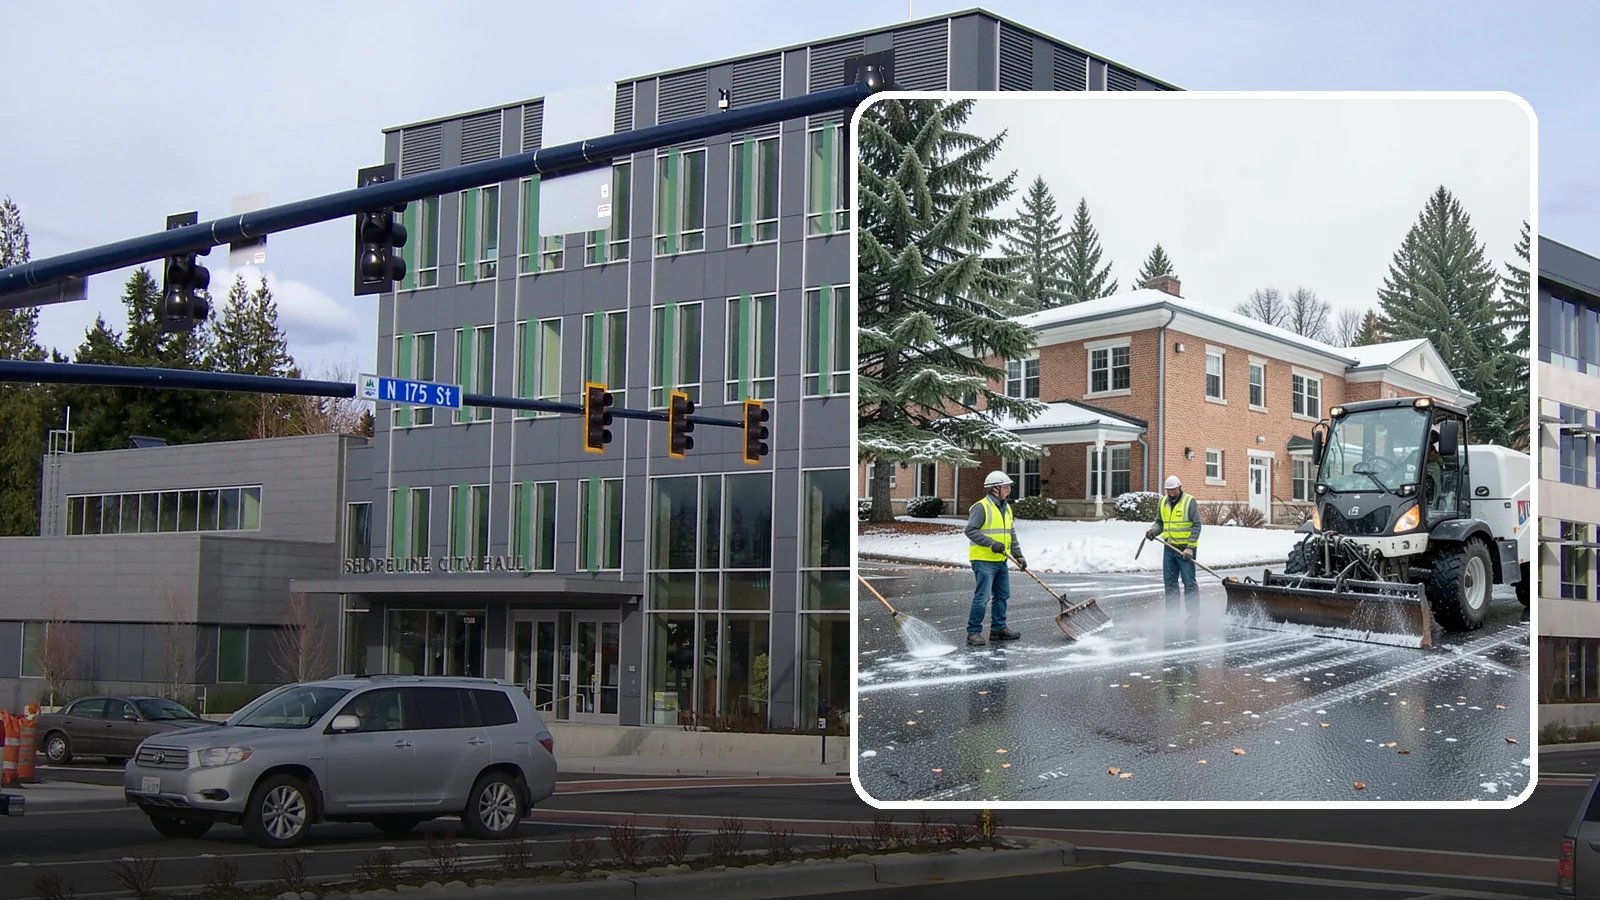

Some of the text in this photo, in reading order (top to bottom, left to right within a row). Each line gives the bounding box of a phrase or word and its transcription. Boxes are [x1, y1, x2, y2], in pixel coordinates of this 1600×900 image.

[387, 380, 451, 405] N 175 St
[344, 556, 525, 574] SHORELINE CITY HALL
